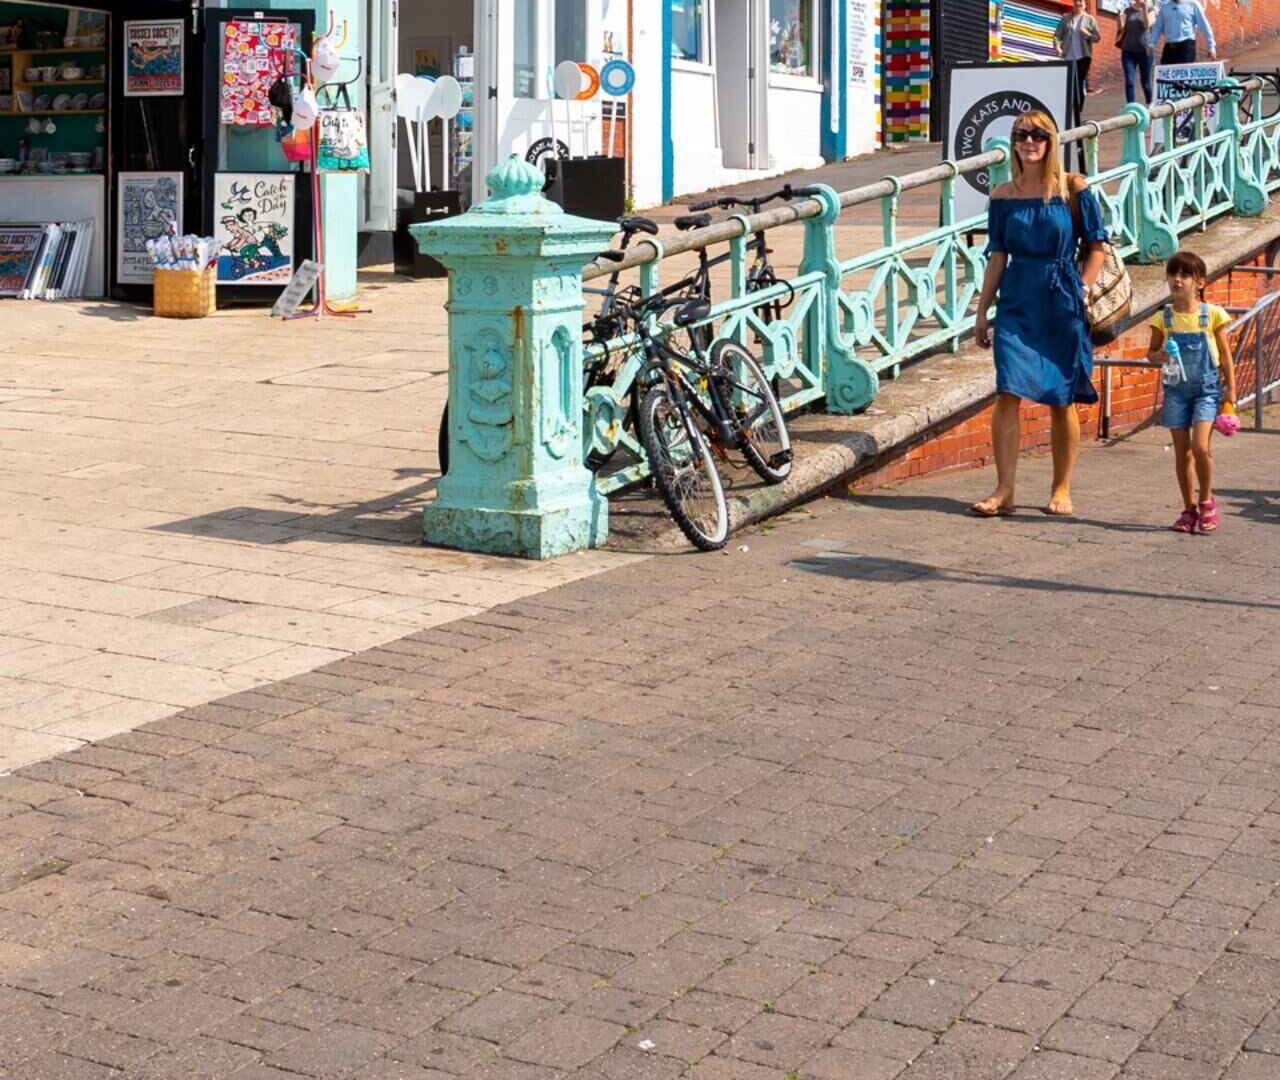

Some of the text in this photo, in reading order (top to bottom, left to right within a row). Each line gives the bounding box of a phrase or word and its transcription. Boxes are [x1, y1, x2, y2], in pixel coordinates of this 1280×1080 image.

[1158, 67, 1217, 79] THE OPEN STUDIOS
[961, 98, 1032, 156] TWO KATS AND
[254, 178, 288, 199] Catch
[257, 198, 287, 218] Day
